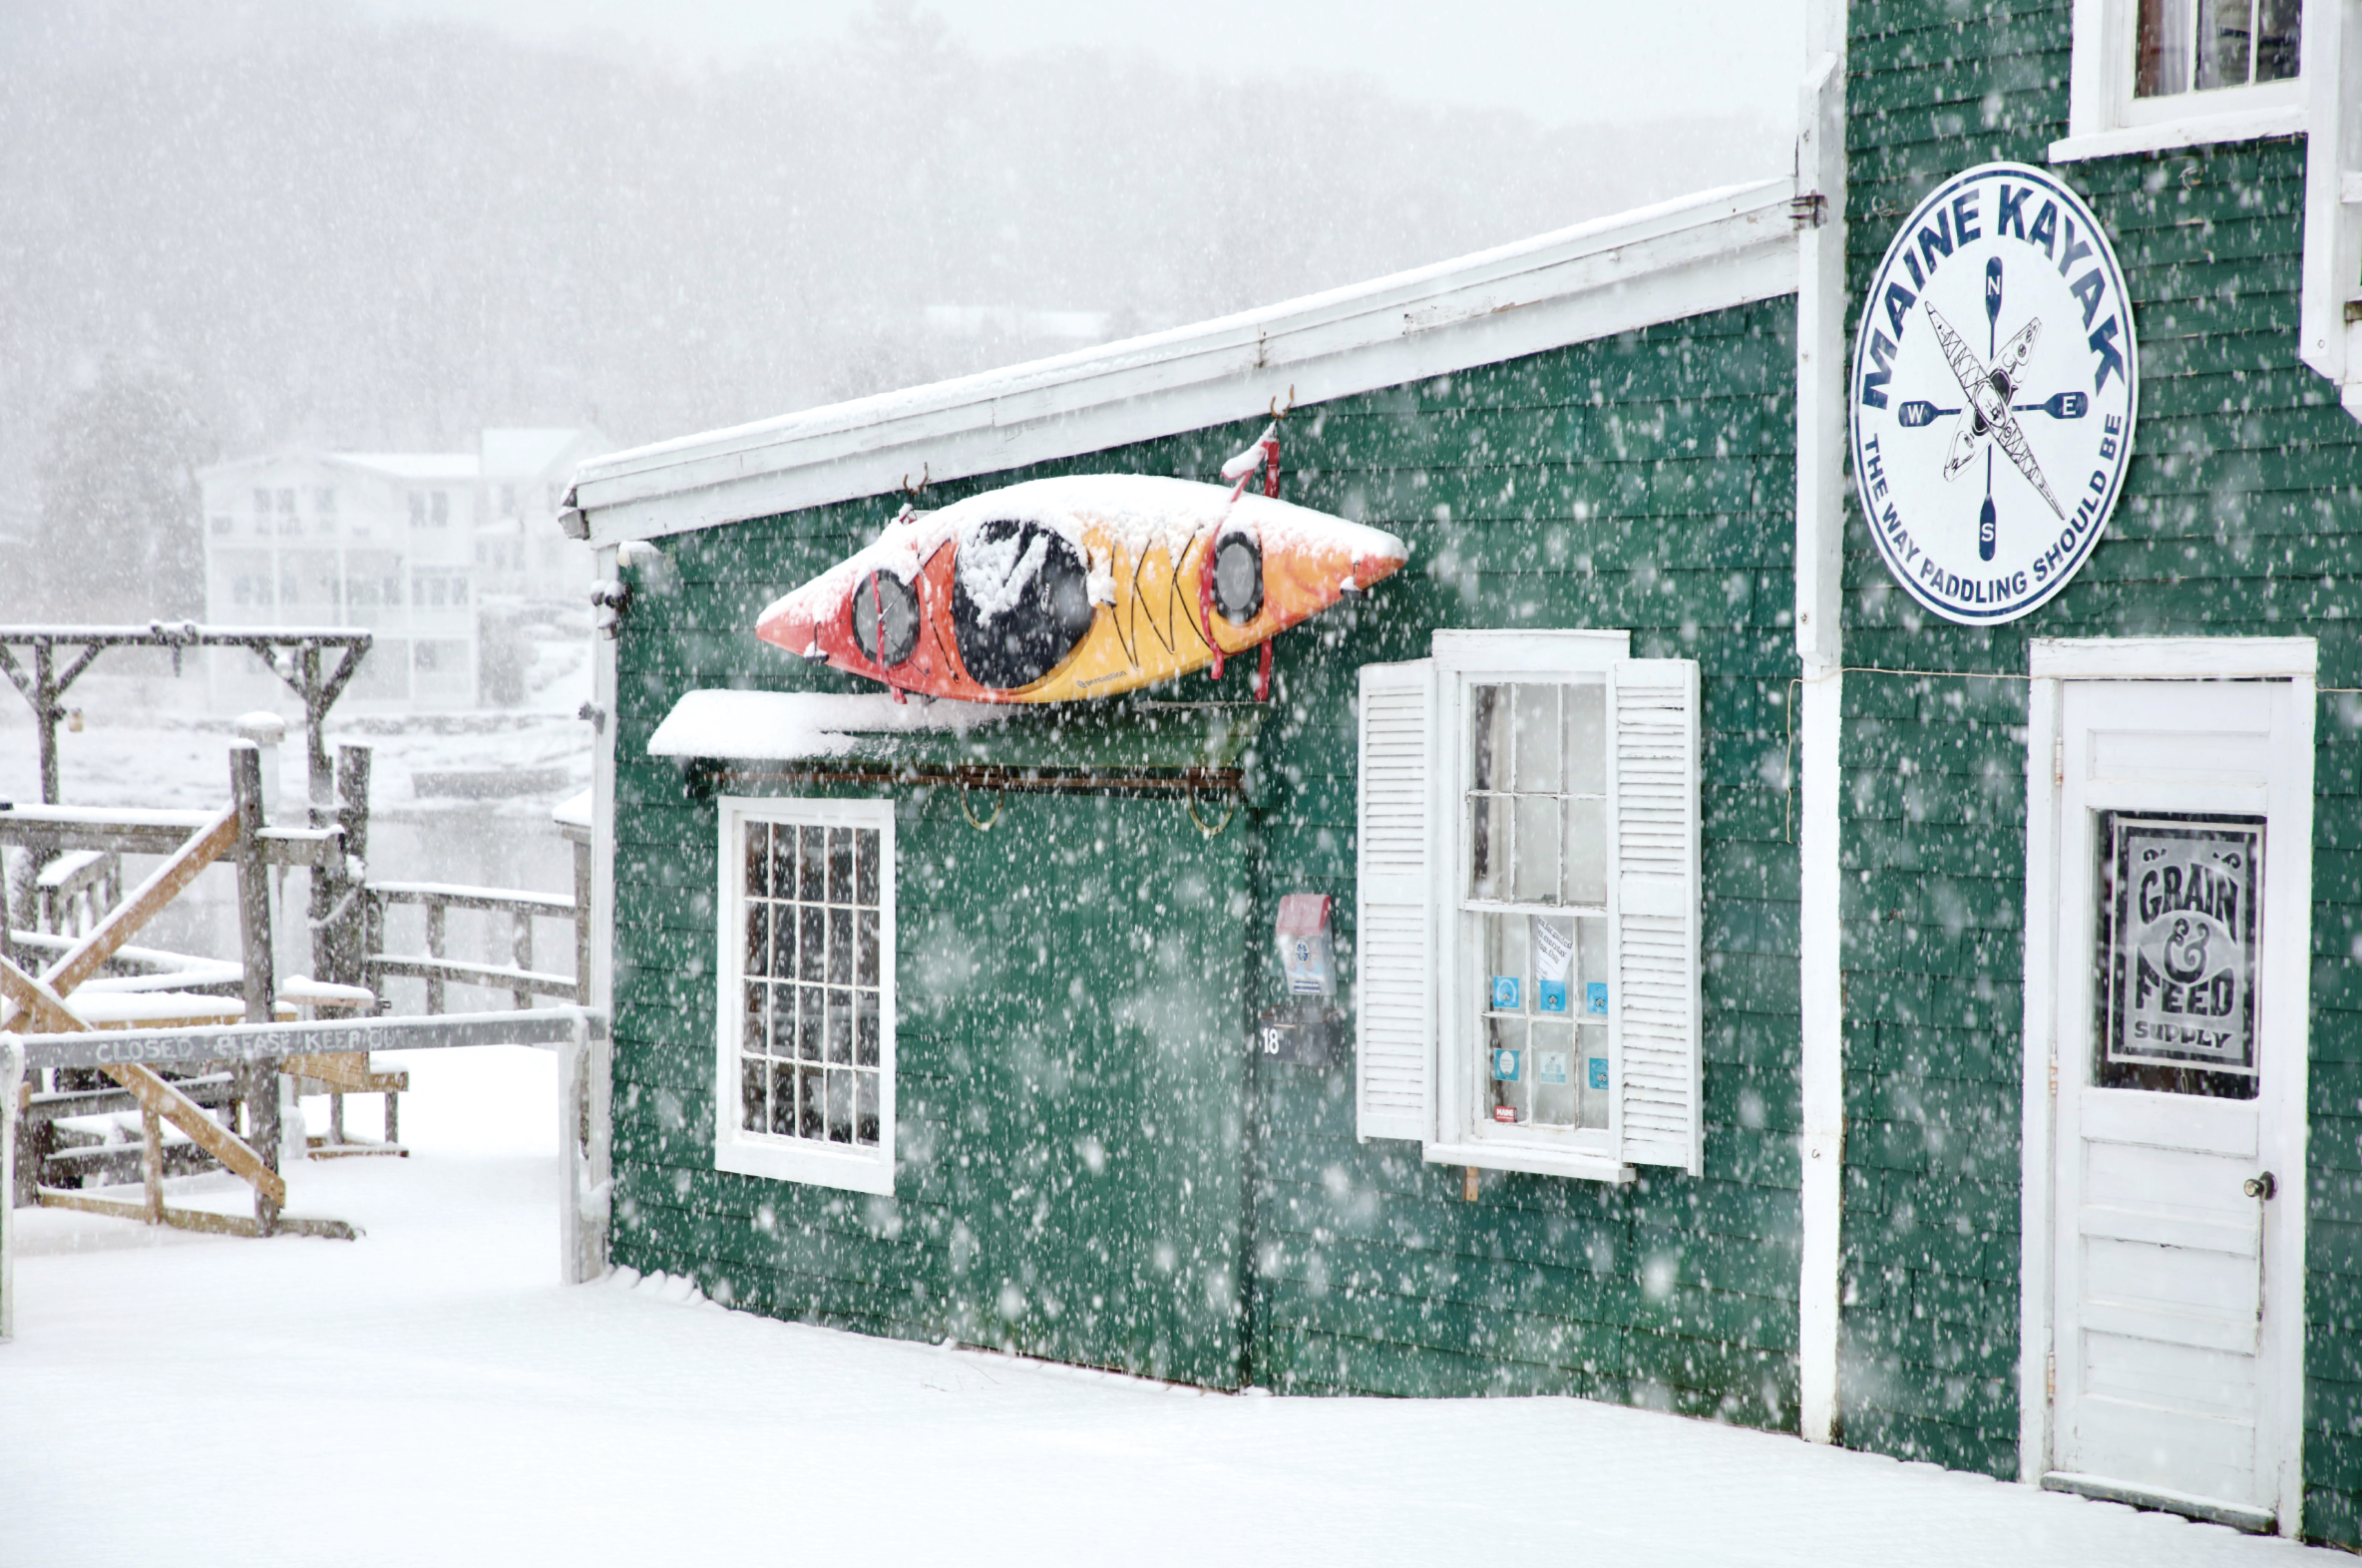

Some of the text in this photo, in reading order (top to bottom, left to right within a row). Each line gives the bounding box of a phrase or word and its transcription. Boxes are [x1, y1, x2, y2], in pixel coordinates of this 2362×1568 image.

[1861, 184, 2126, 410] MAINE KAYAK
[1986, 275, 2001, 295] N
[1906, 404, 1925, 425] W
[2062, 395, 2077, 415] E
[1864, 413, 2122, 604] THE WAY PADDLING SHOULD BE
[1980, 522, 1995, 542] S
[1085, 670, 1127, 686] perception
[2139, 862, 2239, 946] GRAIN
[2163, 917, 2210, 984] &
[2135, 946, 2235, 1017] FEED
[95, 1036, 195, 1063] CLOSED
[216, 1031, 294, 1057] PLEASE
[304, 1028, 361, 1050] KEEP
[1263, 1027, 1279, 1054] 18
[2134, 1019, 2232, 1049] SUPPLY
[1496, 1107, 1514, 1117] MAINE
